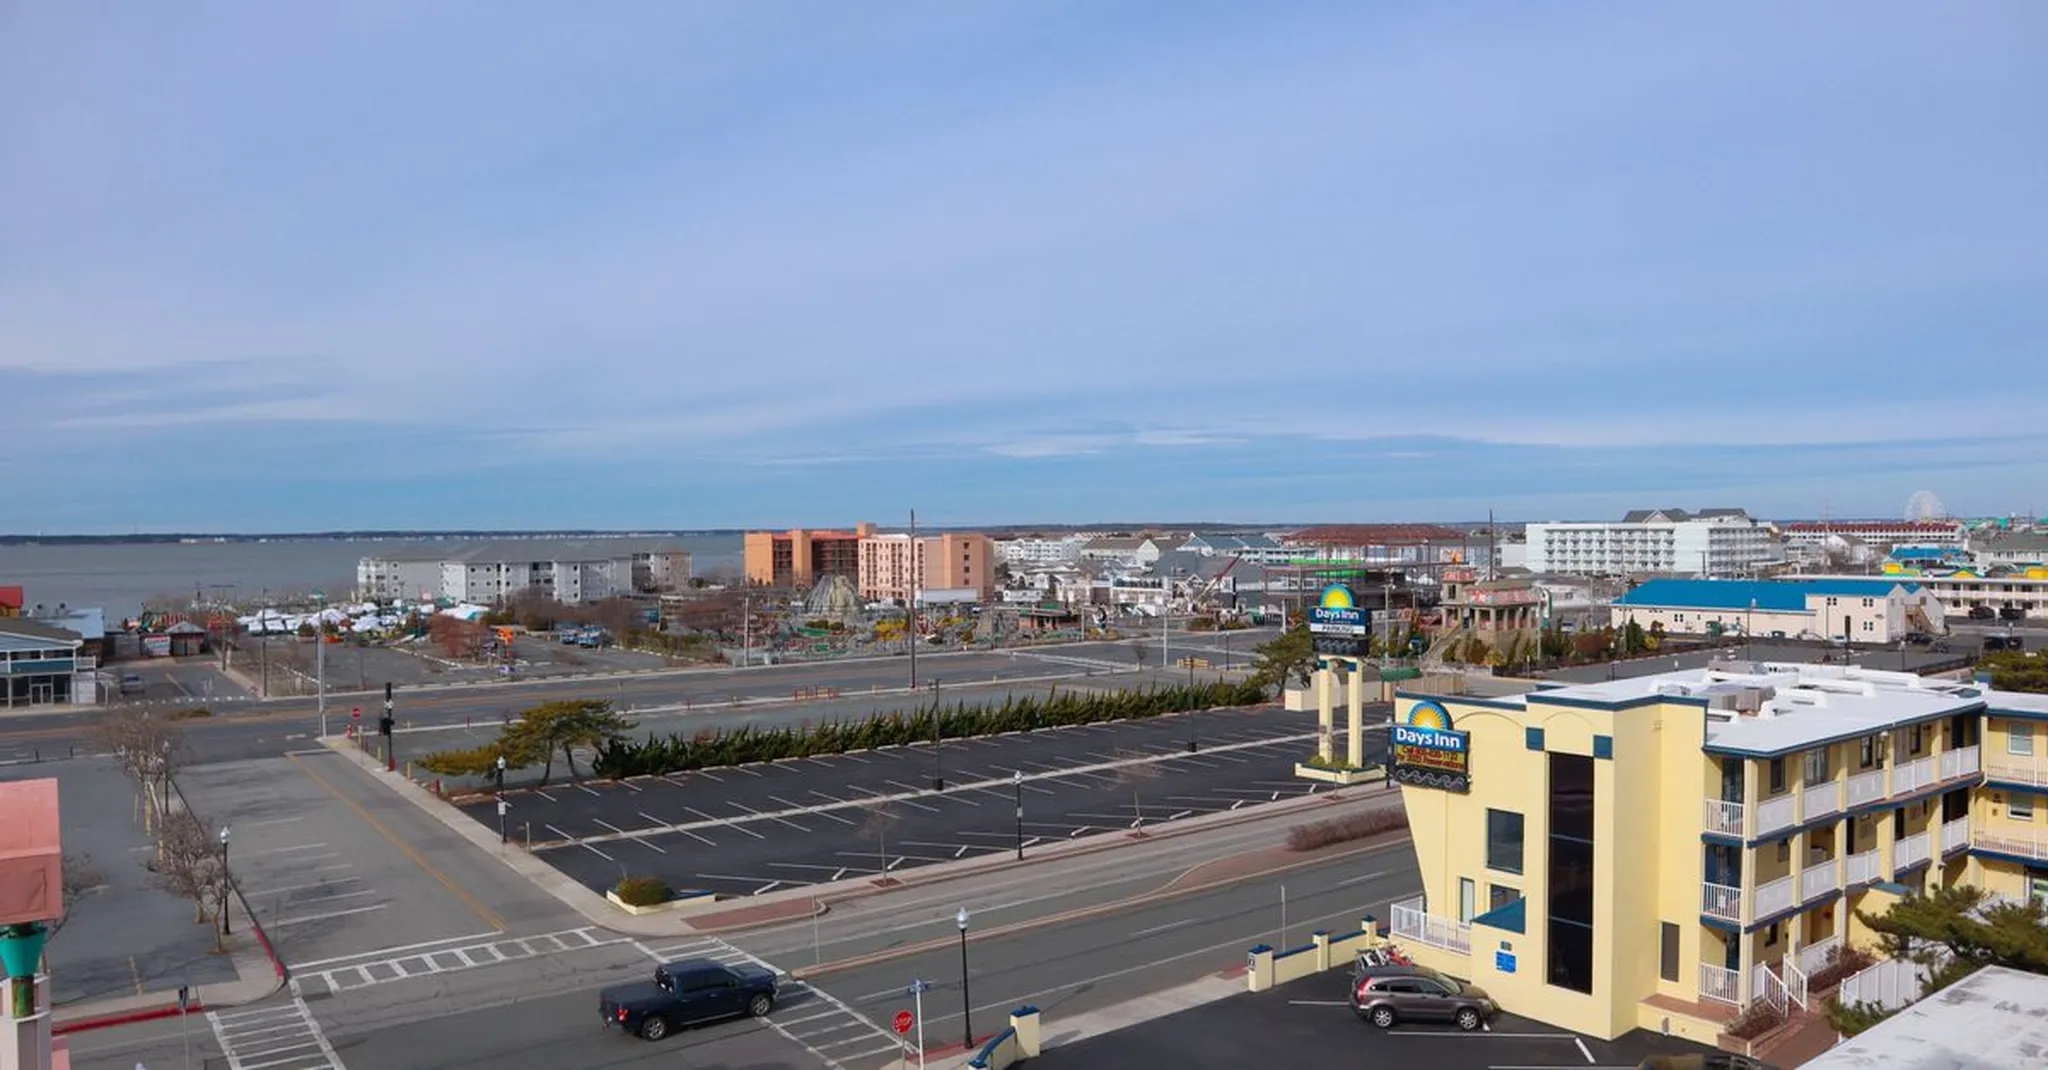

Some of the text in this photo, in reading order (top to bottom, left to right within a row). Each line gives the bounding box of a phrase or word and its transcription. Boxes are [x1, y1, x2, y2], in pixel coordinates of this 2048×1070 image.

[1315, 608, 1360, 621] Days Inn
[1396, 728, 1460, 748] Days Inn
[895, 1016, 912, 1028] STOP
